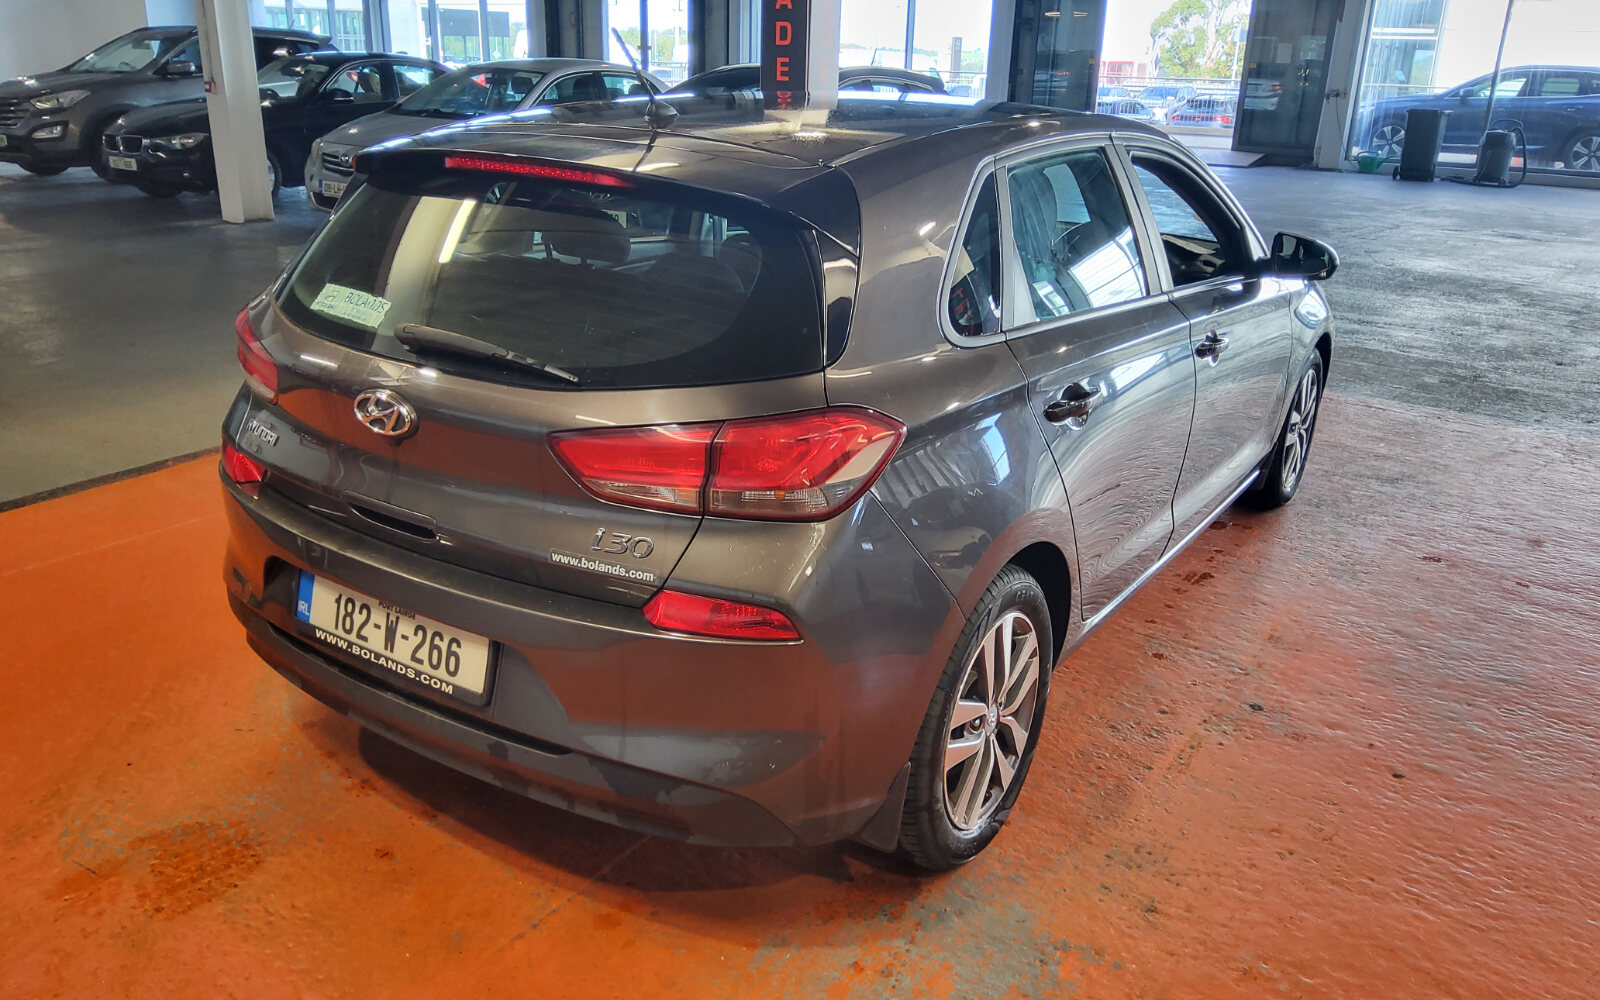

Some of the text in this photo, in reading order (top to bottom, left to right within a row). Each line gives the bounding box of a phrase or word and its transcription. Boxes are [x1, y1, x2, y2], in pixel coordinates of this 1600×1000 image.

[344, 292, 388, 313] BOLANDS
[247, 419, 279, 447] HYUNDAI
[591, 527, 655, 558] i30
[551, 552, 654, 582] www.bolands.com
[298, 600, 310, 616] IRL
[334, 593, 462, 677] 182-W-266
[315, 628, 454, 694] WWW.BOLANDS.COM
